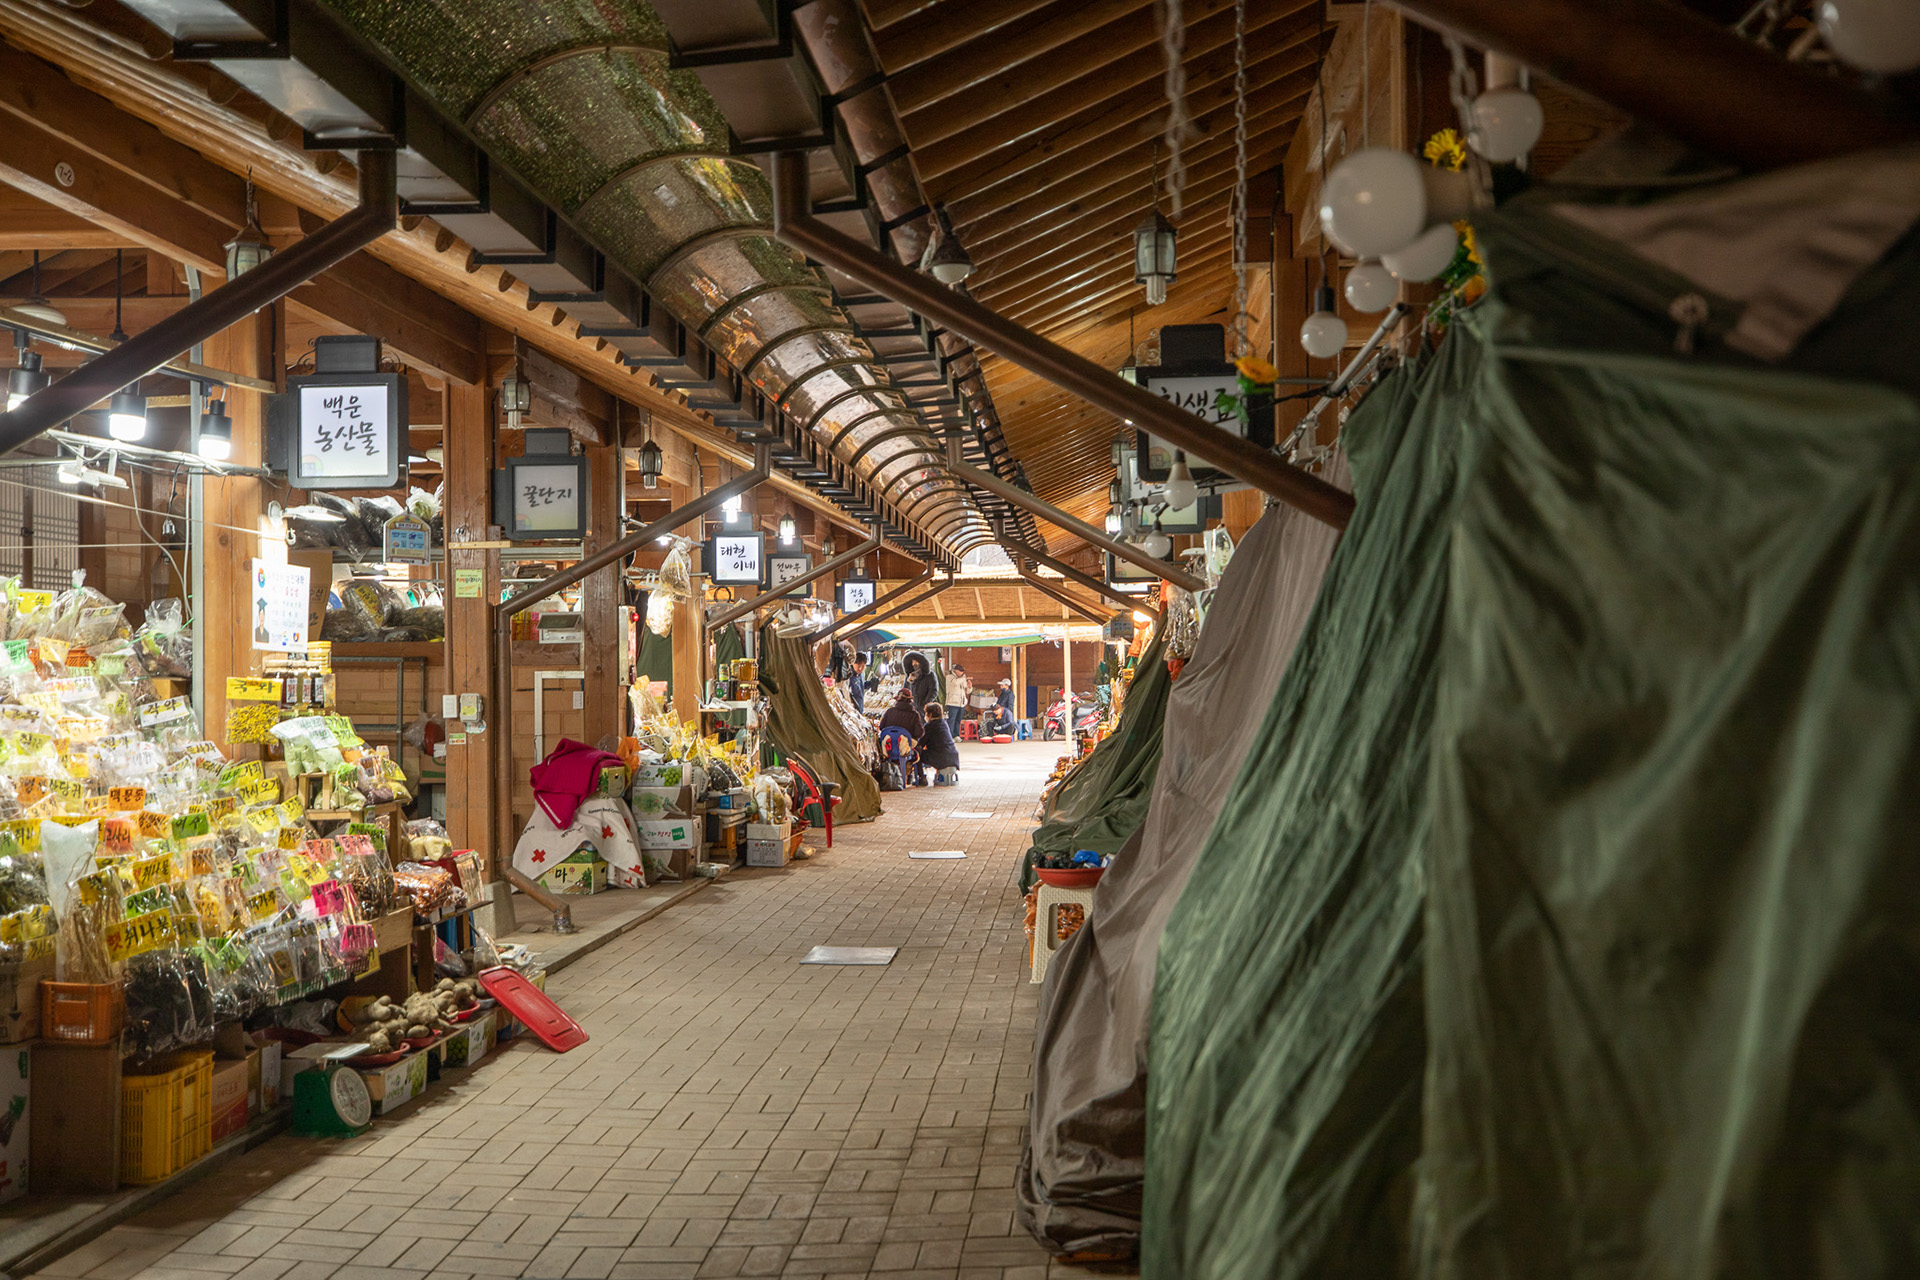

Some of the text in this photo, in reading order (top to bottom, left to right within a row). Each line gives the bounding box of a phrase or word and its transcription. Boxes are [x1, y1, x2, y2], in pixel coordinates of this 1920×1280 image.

[322, 395, 362, 419] 백운
[313, 421, 380, 456] 농산물
[522, 485, 572, 508] 꿀단지
[720, 544, 746, 558] 태현
[733, 560, 756, 571] 이네
[230, 677, 276, 695] 국화
[147, 699, 177, 717] 작약
[109, 787, 144, 803] 맥문동
[175, 816, 202, 834] 여주
[142, 859, 171, 886] 취나물
[555, 867, 568, 884] 마
[124, 916, 168, 947] 취나물
